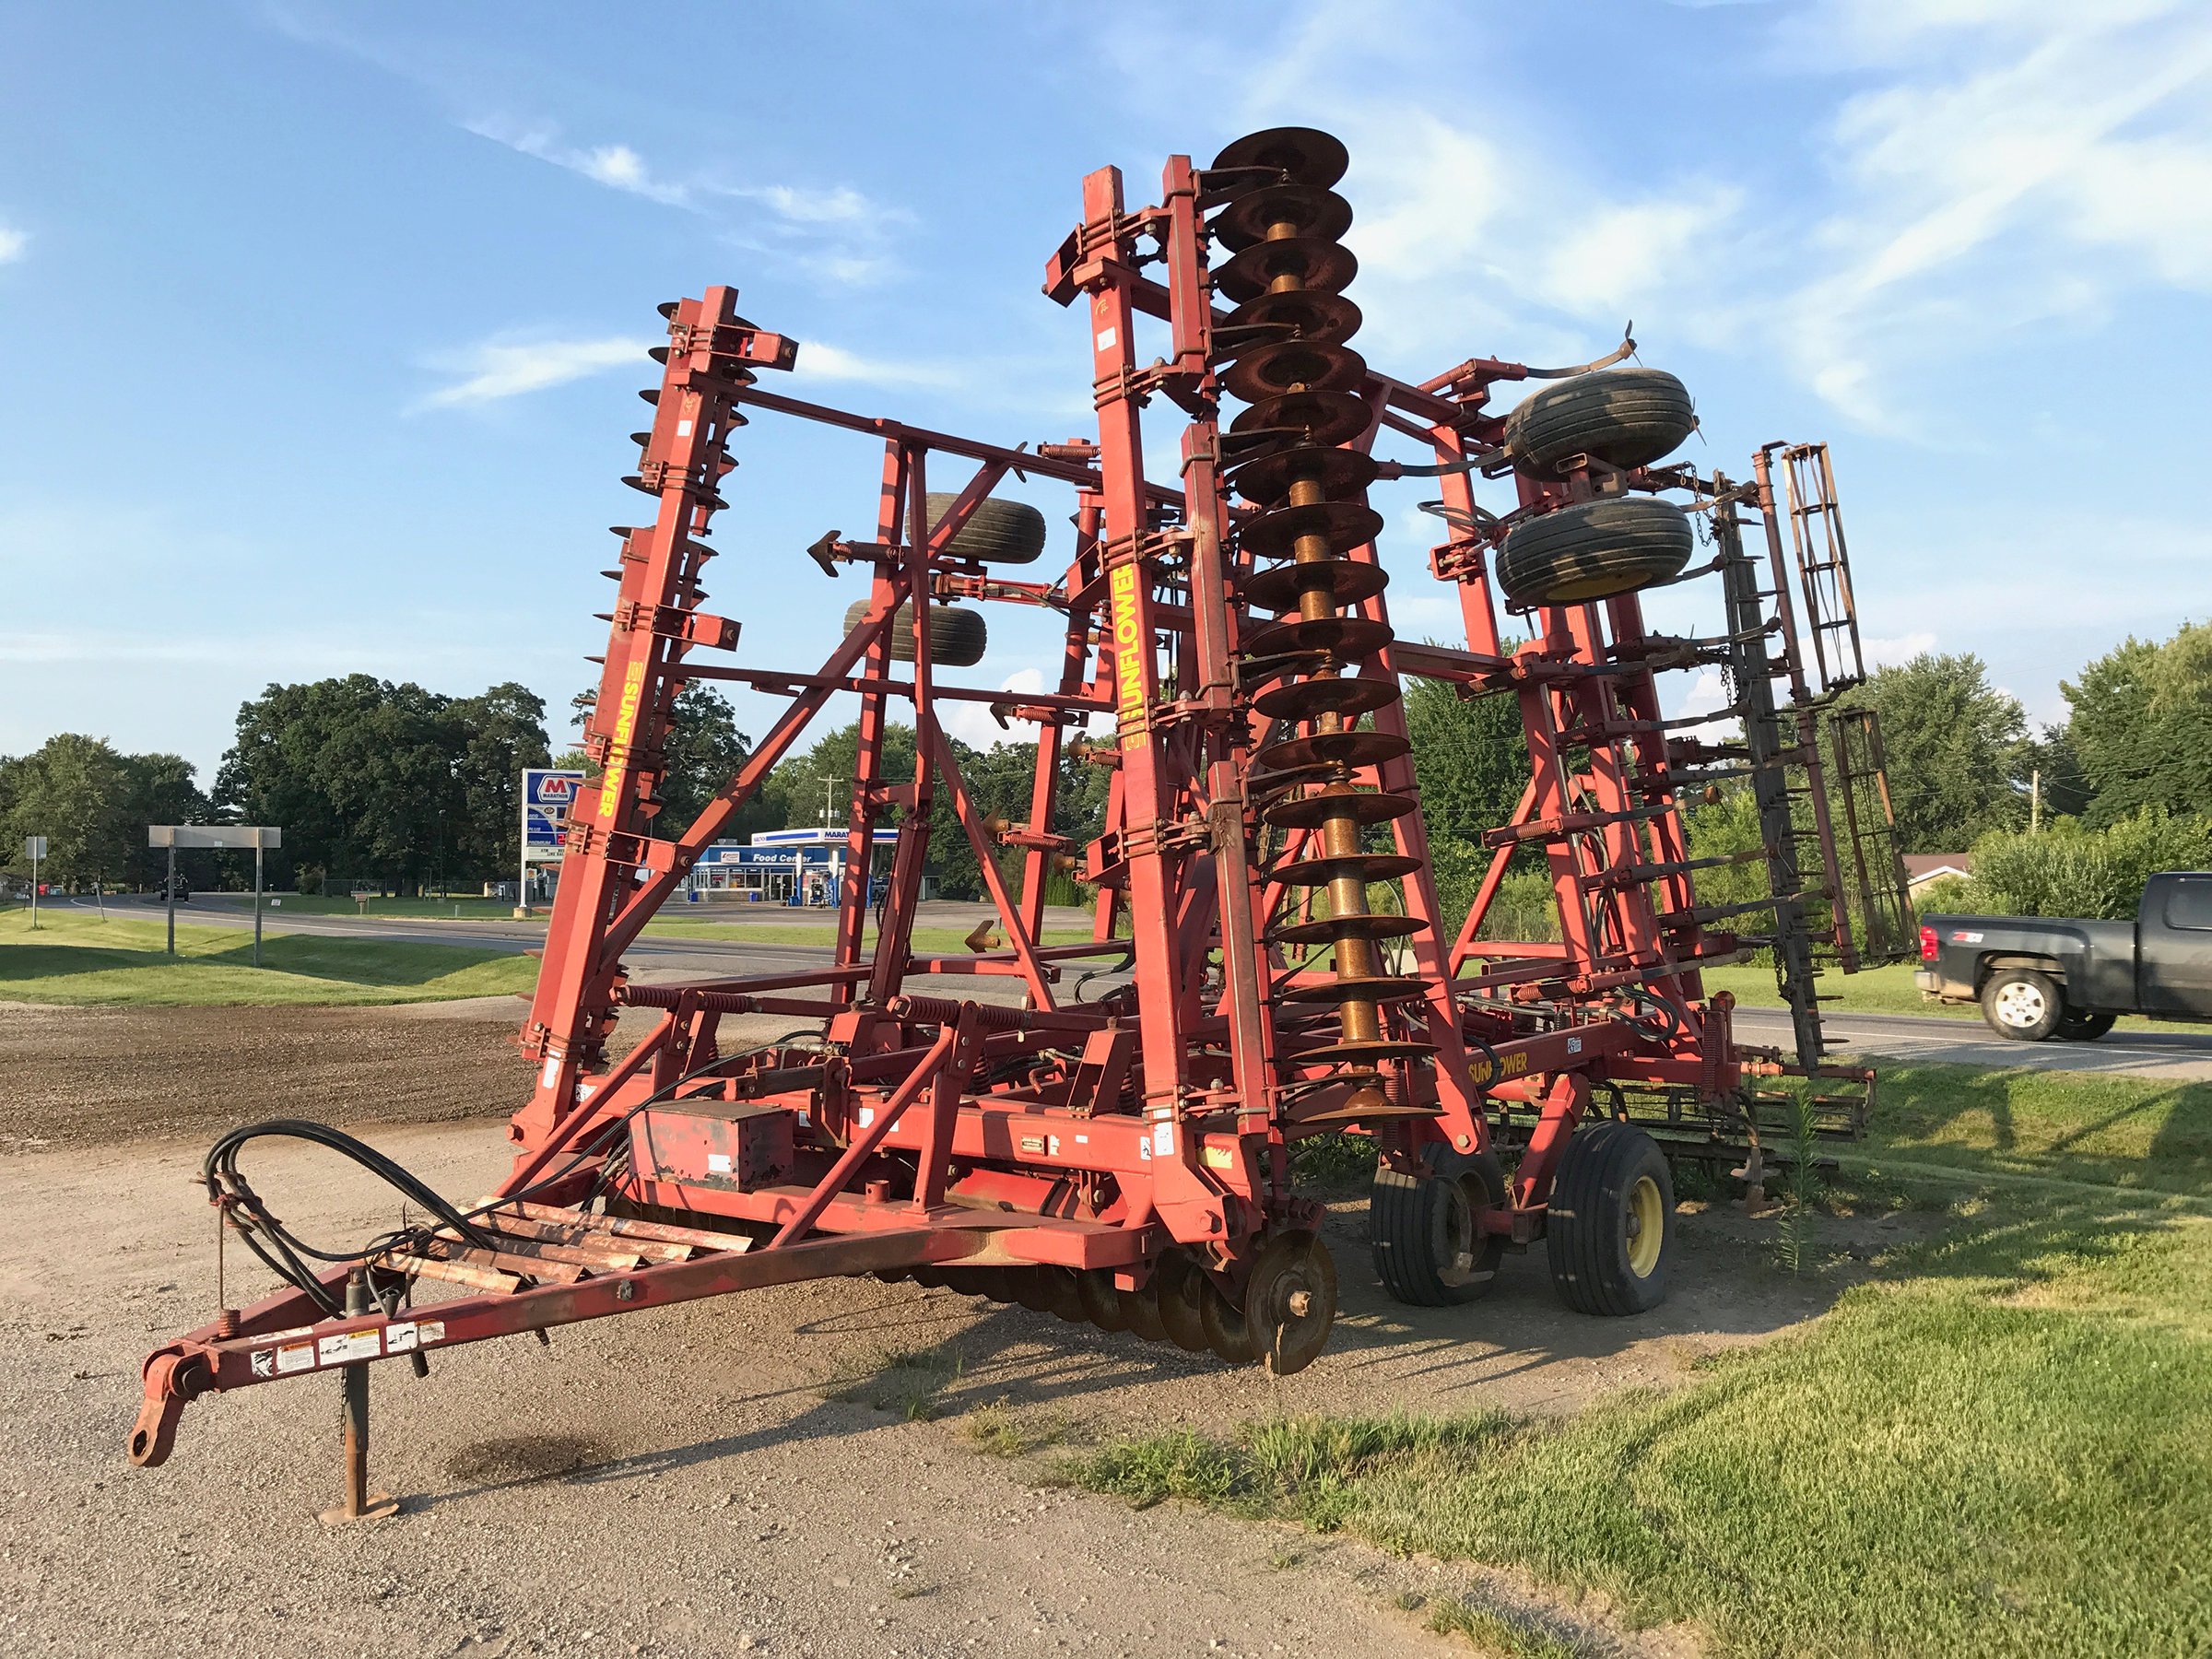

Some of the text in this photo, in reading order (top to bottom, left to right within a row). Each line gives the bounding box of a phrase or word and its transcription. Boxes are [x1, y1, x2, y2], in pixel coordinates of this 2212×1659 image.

[545, 779, 567, 794] M
[753, 853, 812, 863] Food Cener
[1468, 1052, 1527, 1083] SUNFOWER
